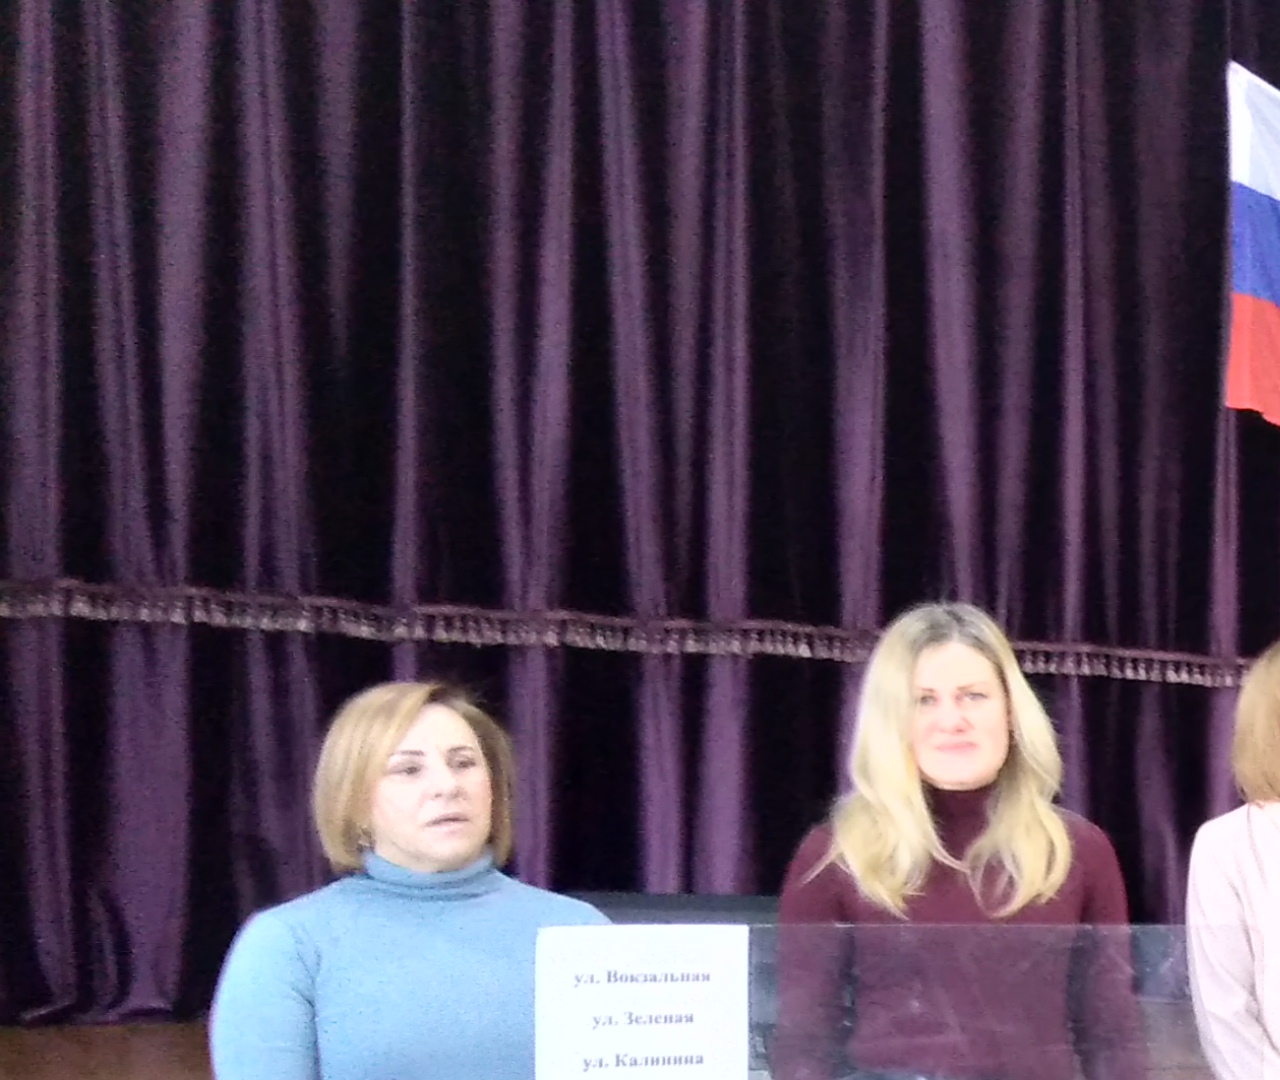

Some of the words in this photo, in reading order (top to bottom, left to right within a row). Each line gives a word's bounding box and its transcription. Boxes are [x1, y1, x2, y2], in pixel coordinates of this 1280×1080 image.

[573, 972, 600, 988] ул.
[607, 969, 711, 984] Вокзальная
[592, 1014, 618, 1030] ул.
[624, 1011, 694, 1026] Зеленая
[583, 1057, 609, 1072] ул.
[615, 1053, 704, 1068] Калинина
